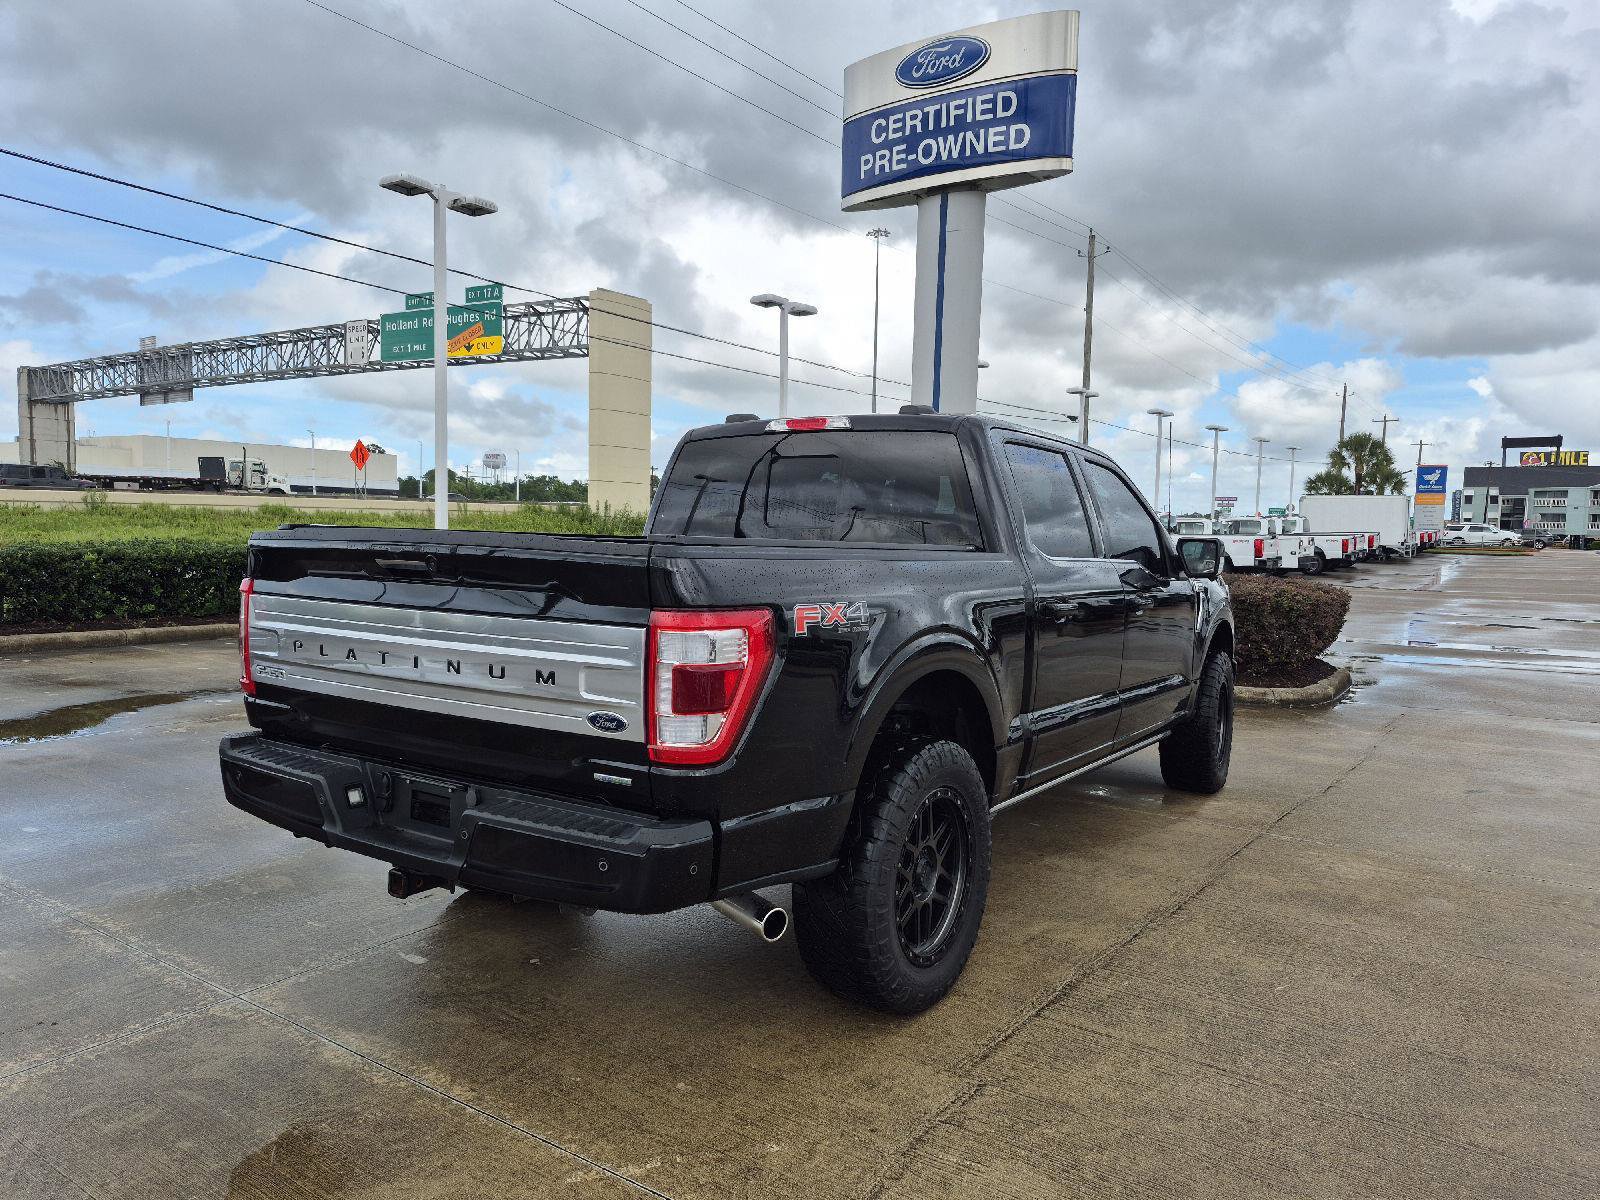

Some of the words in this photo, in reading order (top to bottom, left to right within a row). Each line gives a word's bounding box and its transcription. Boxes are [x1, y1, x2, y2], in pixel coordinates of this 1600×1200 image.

[912, 43, 966, 78] Ford
[870, 91, 1018, 144] CERTIFIED
[860, 123, 1031, 179] PRE-OWNED
[483, 288, 491, 298] 17
[493, 287, 499, 297] A
[385, 319, 418, 332] Holland
[422, 317, 434, 328] Rd
[446, 311, 480, 326] Hughes
[484, 309, 496, 321] Rd
[347, 325, 367, 333] SPEED
[413, 343, 426, 351] MILE
[1550, 451, 1588, 466] MILE
[793, 600, 870, 637] FX4
[293, 639, 556, 686] PLATINUM
